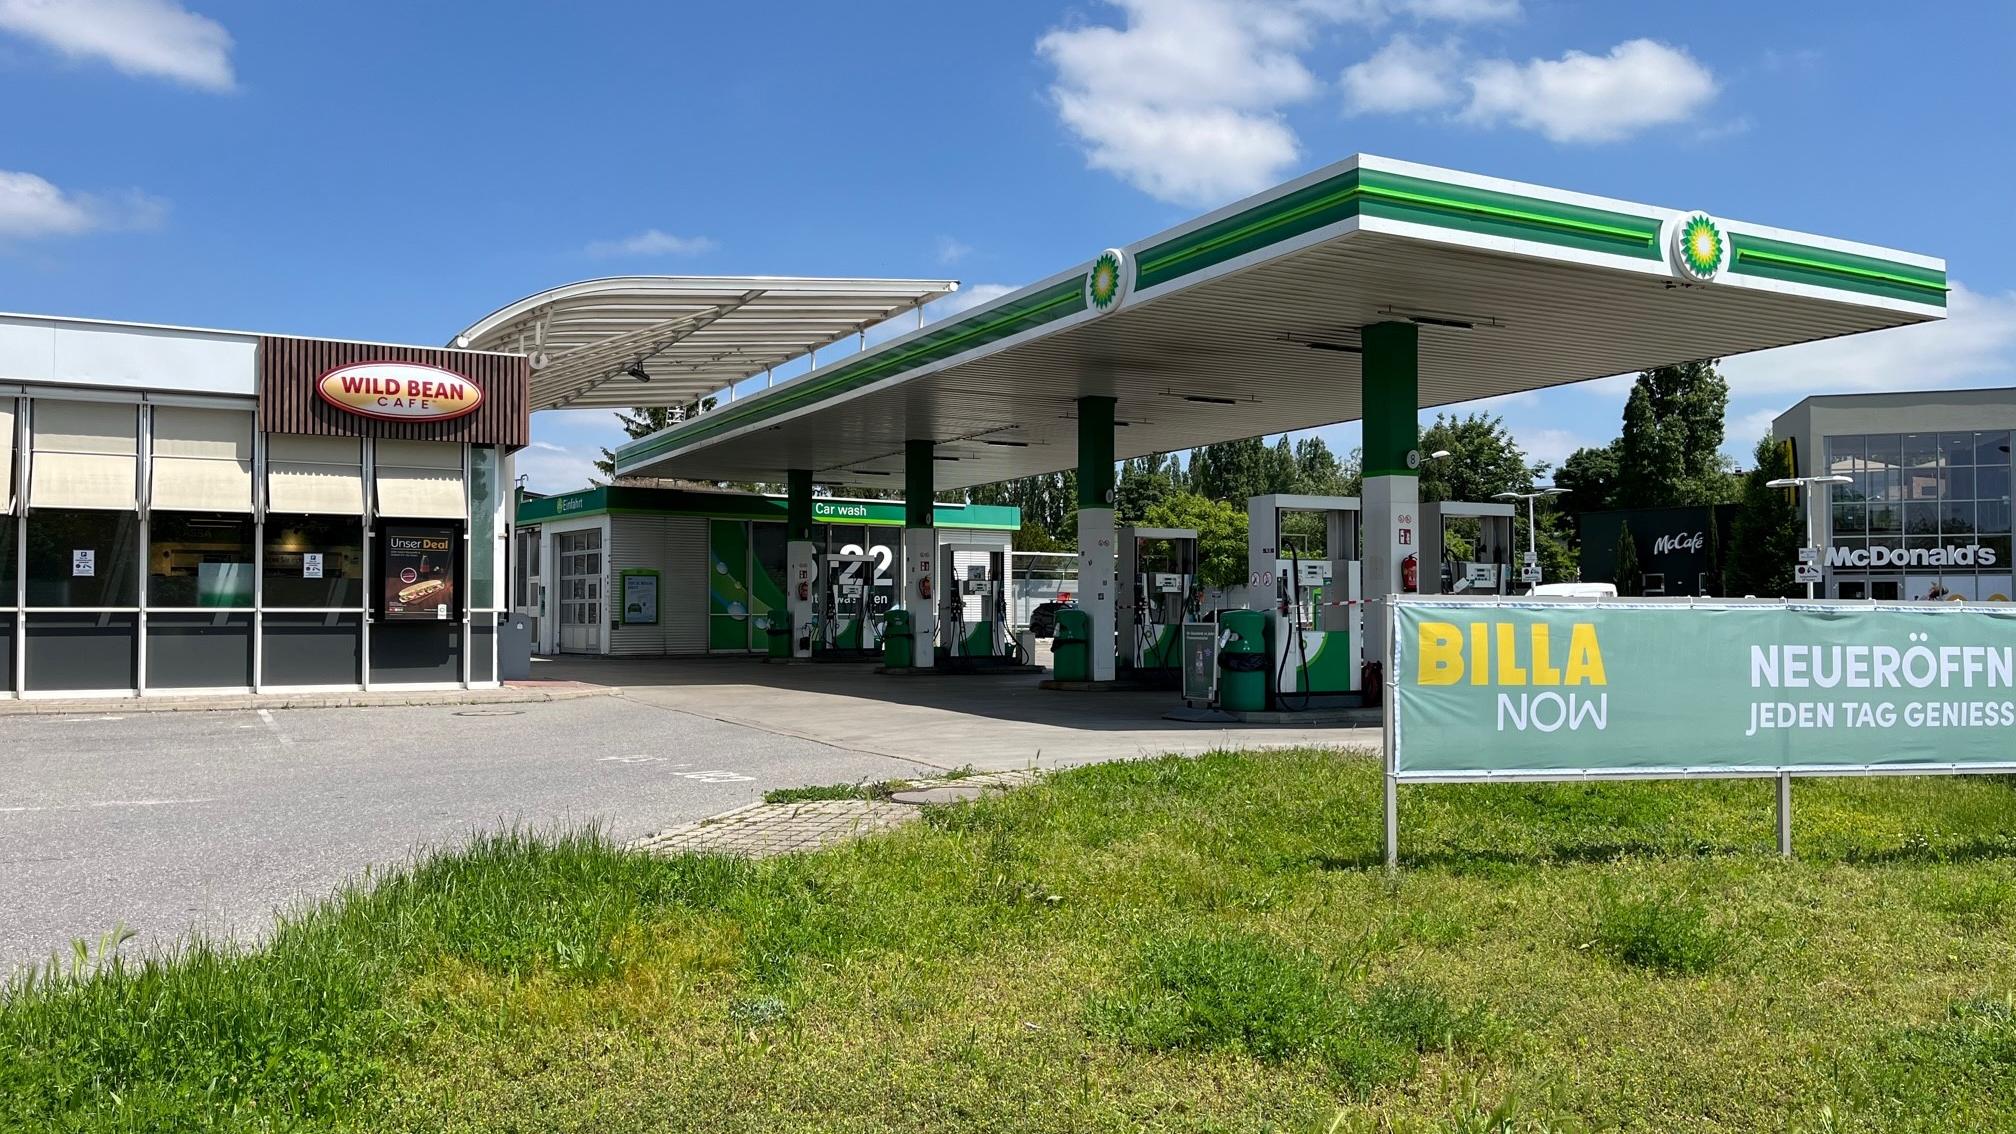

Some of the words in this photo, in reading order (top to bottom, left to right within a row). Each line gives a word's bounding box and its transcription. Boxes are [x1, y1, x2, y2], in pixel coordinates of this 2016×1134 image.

[341, 376, 400, 396] WILD
[407, 379, 464, 401] BEAN
[1410, 454, 1416, 465] 8
[562, 497, 583, 511] Einfahrt
[815, 502, 834, 514] Car
[838, 504, 867, 516] wash
[390, 537, 421, 549] Unser
[423, 538, 449, 550] Deal
[1653, 531, 1704, 555] McCafé
[1823, 544, 1997, 567] McDonald's
[1417, 622, 1608, 686] BILLA
[1750, 632, 2013, 688] NEUERÖFFN
[1497, 690, 1608, 733] NOW
[1745, 702, 1834, 737] JEDEN
[1842, 702, 1898, 728] TAG
[1903, 701, 2016, 728] GENIESS
